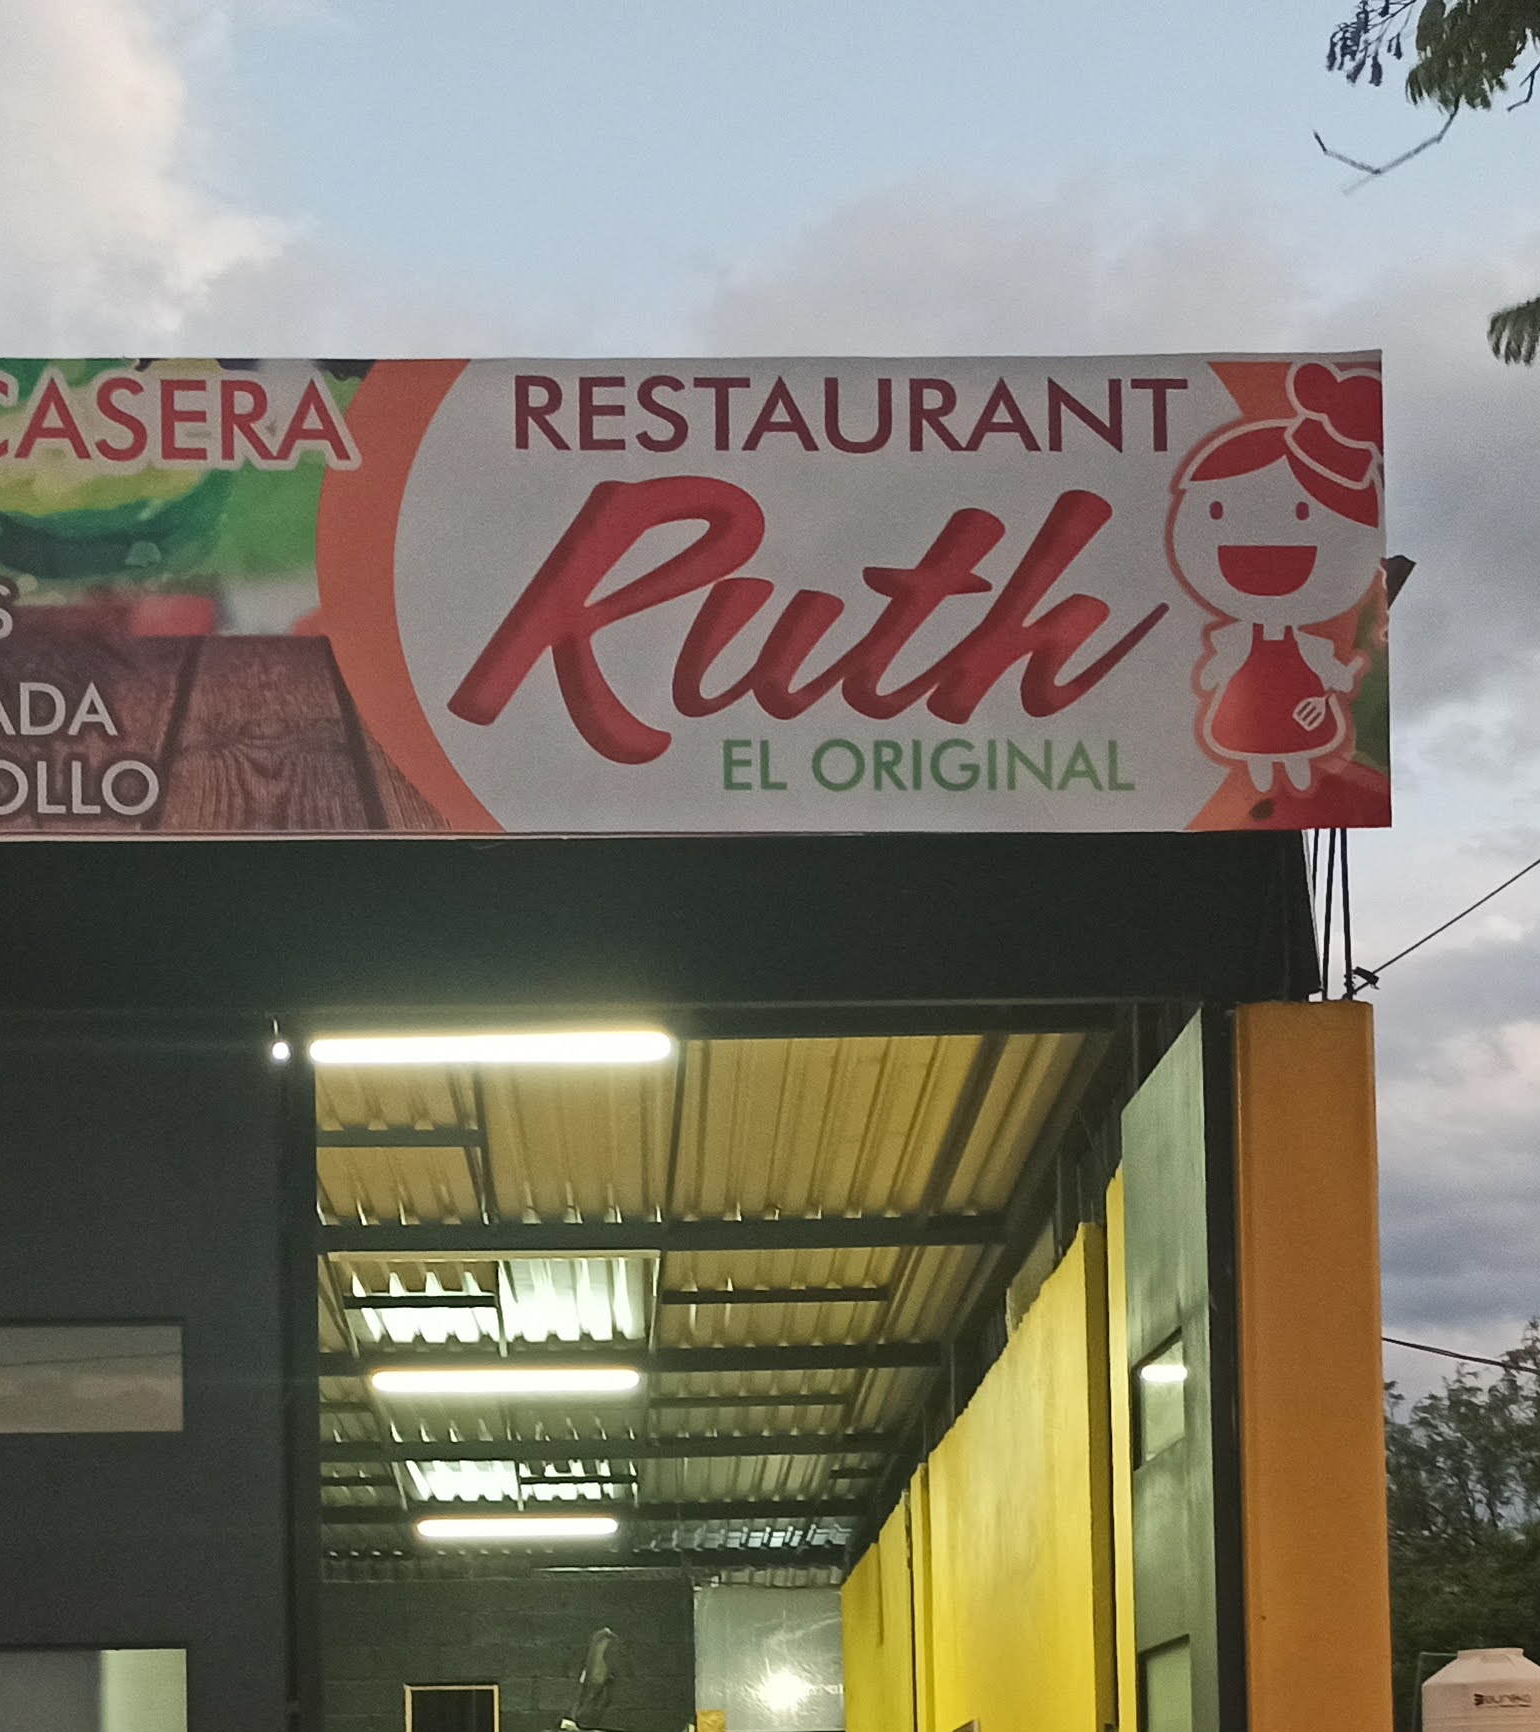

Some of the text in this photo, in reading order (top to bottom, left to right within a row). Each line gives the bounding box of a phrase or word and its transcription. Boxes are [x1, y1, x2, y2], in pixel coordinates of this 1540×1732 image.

[514, 374, 1189, 454] RESTAURANT
[446, 474, 1170, 765] Ruth
[721, 737, 1135, 793] EL ORIGINAL
